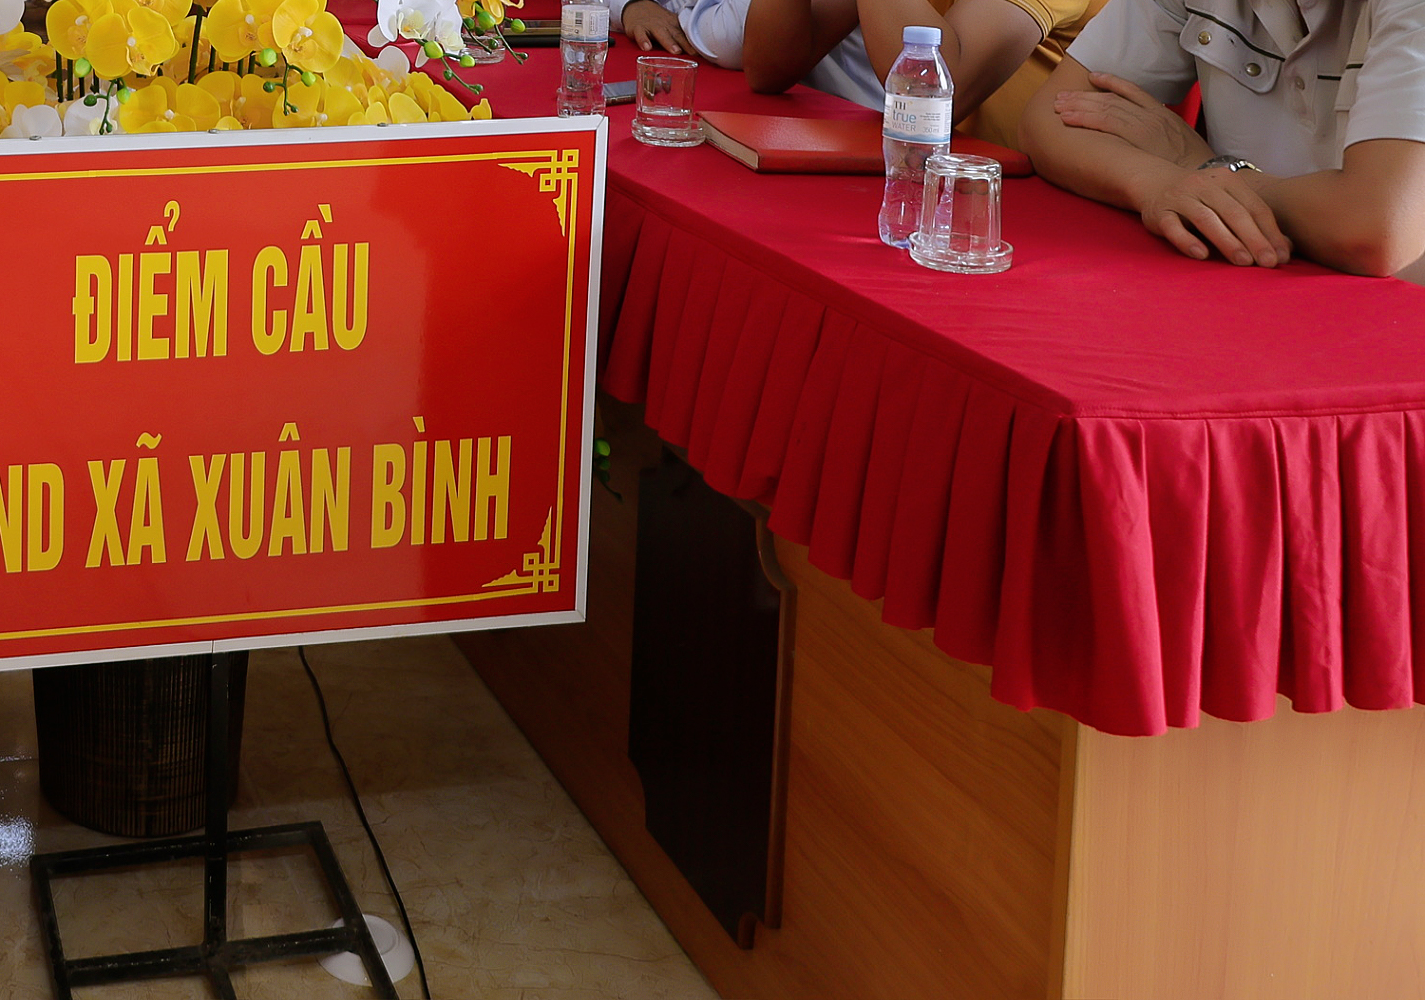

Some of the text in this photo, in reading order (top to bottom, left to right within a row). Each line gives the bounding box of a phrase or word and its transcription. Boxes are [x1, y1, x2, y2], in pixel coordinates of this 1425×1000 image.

[892, 121, 916, 132] WATER
[893, 110, 916, 123] true
[72, 200, 369, 364] ĐIỂM CẦU
[86, 432, 166, 567] XÃ
[186, 422, 351, 561] XUÂN
[371, 416, 511, 548] BÌNH
